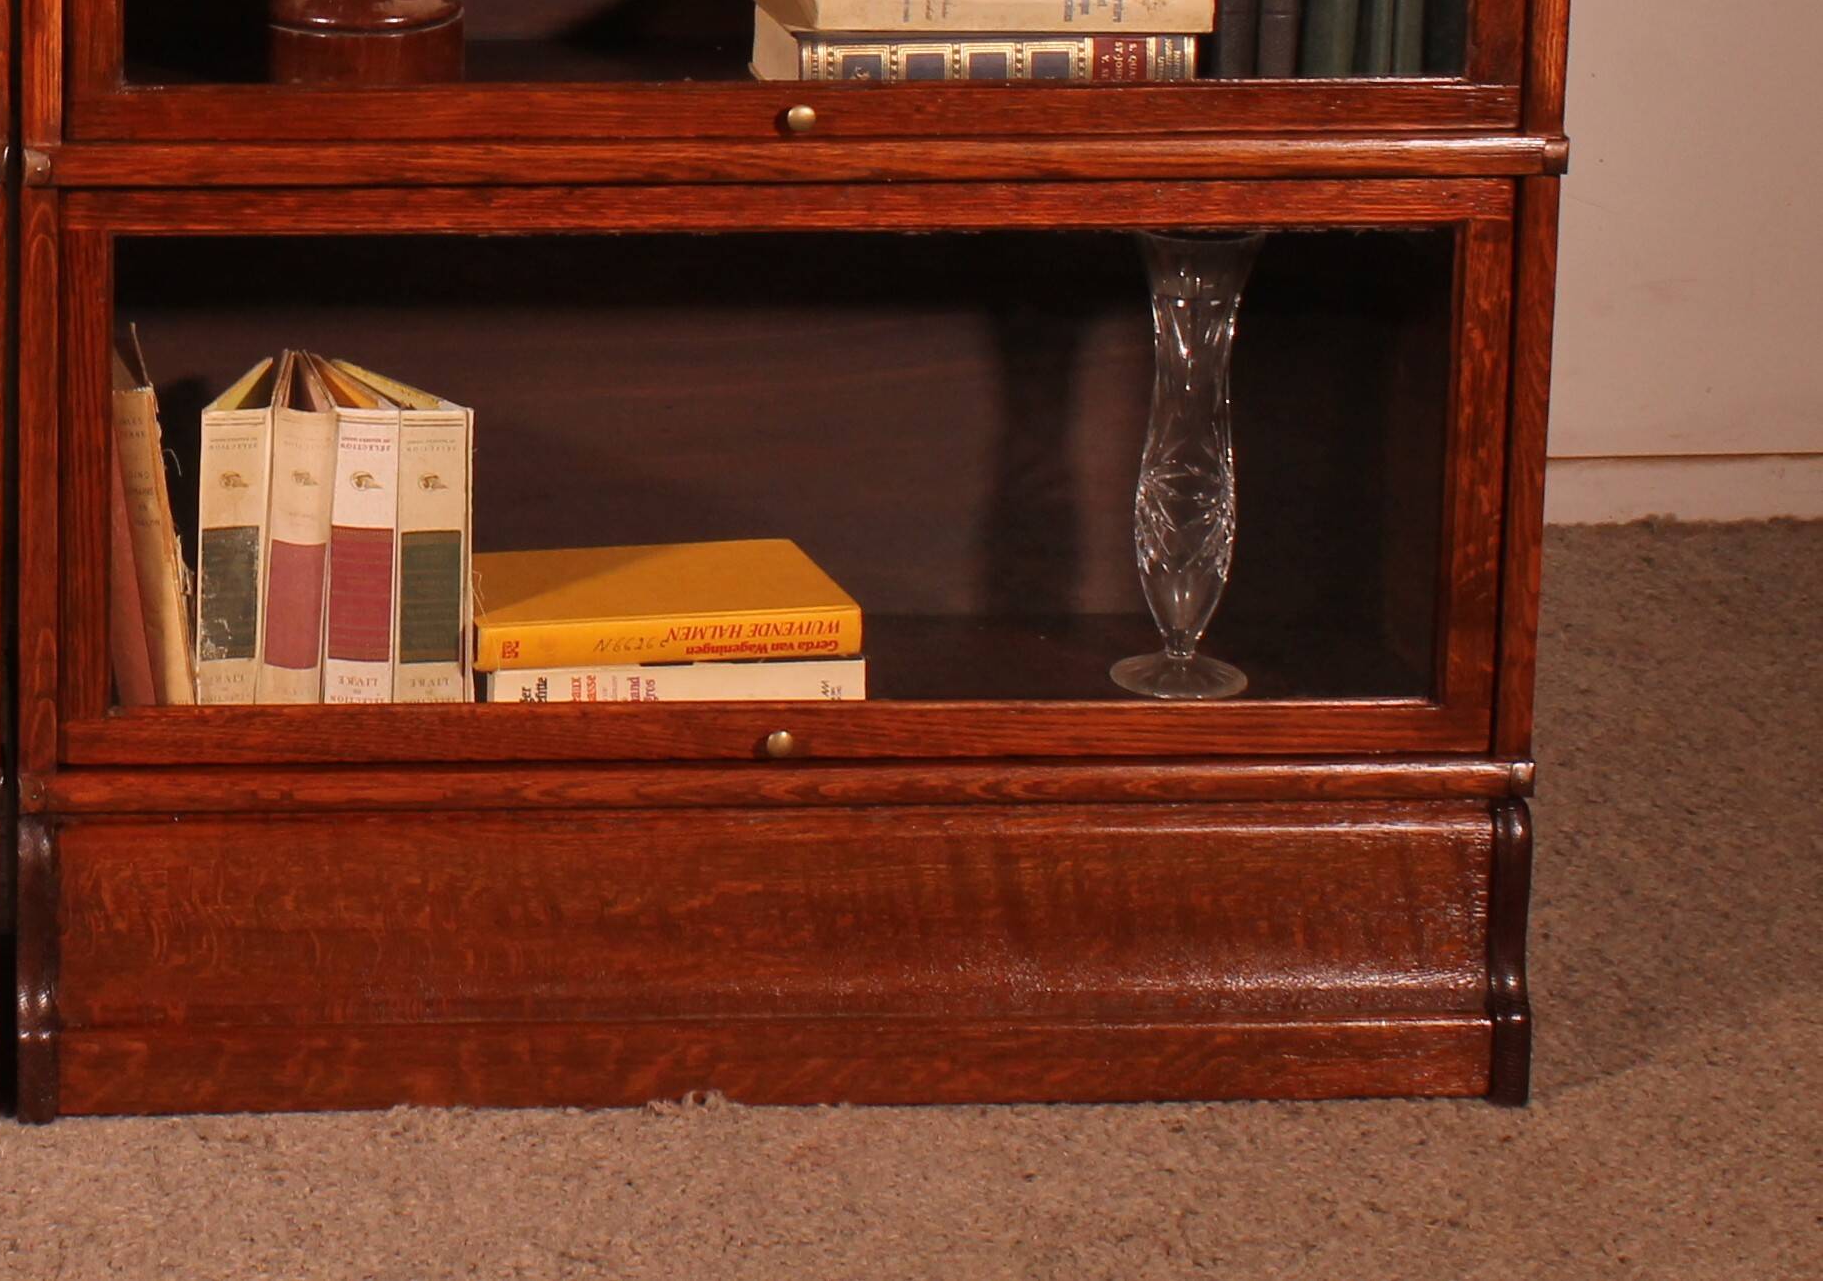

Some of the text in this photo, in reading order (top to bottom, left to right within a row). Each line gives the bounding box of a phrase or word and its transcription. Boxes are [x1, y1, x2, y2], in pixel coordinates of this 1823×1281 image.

[665, 619, 842, 642] WUIVENDE HALMEN
[685, 639, 840, 656] Gerda van Wageningen
[337, 675, 380, 687] LIVRE
[409, 676, 450, 688] LIVRE
